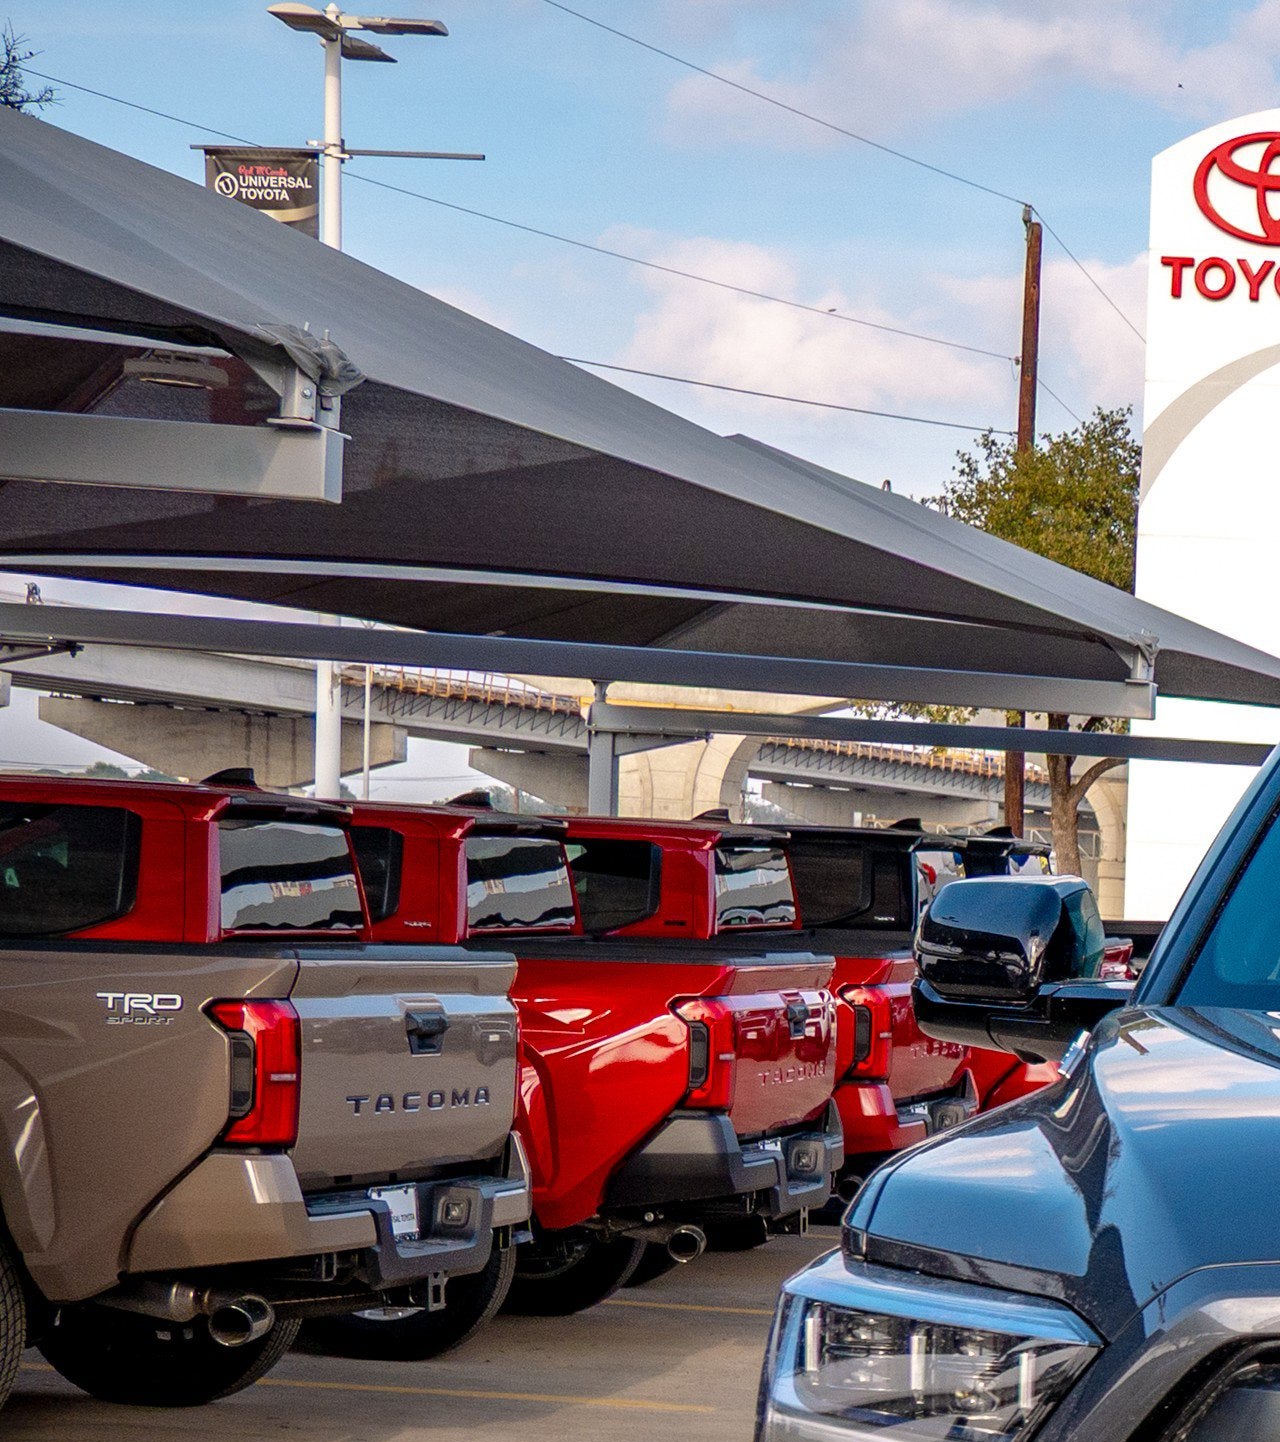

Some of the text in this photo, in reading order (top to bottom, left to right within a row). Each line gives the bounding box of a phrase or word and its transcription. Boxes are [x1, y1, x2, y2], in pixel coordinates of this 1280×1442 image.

[239, 175, 312, 189] UNIVERSAL
[239, 188, 290, 201] TOYOTA
[96, 992, 182, 1014] TRD
[106, 1016, 175, 1026] SPORT
[758, 1060, 826, 1087] TACOMA
[346, 1086, 490, 1117] TACOMA
